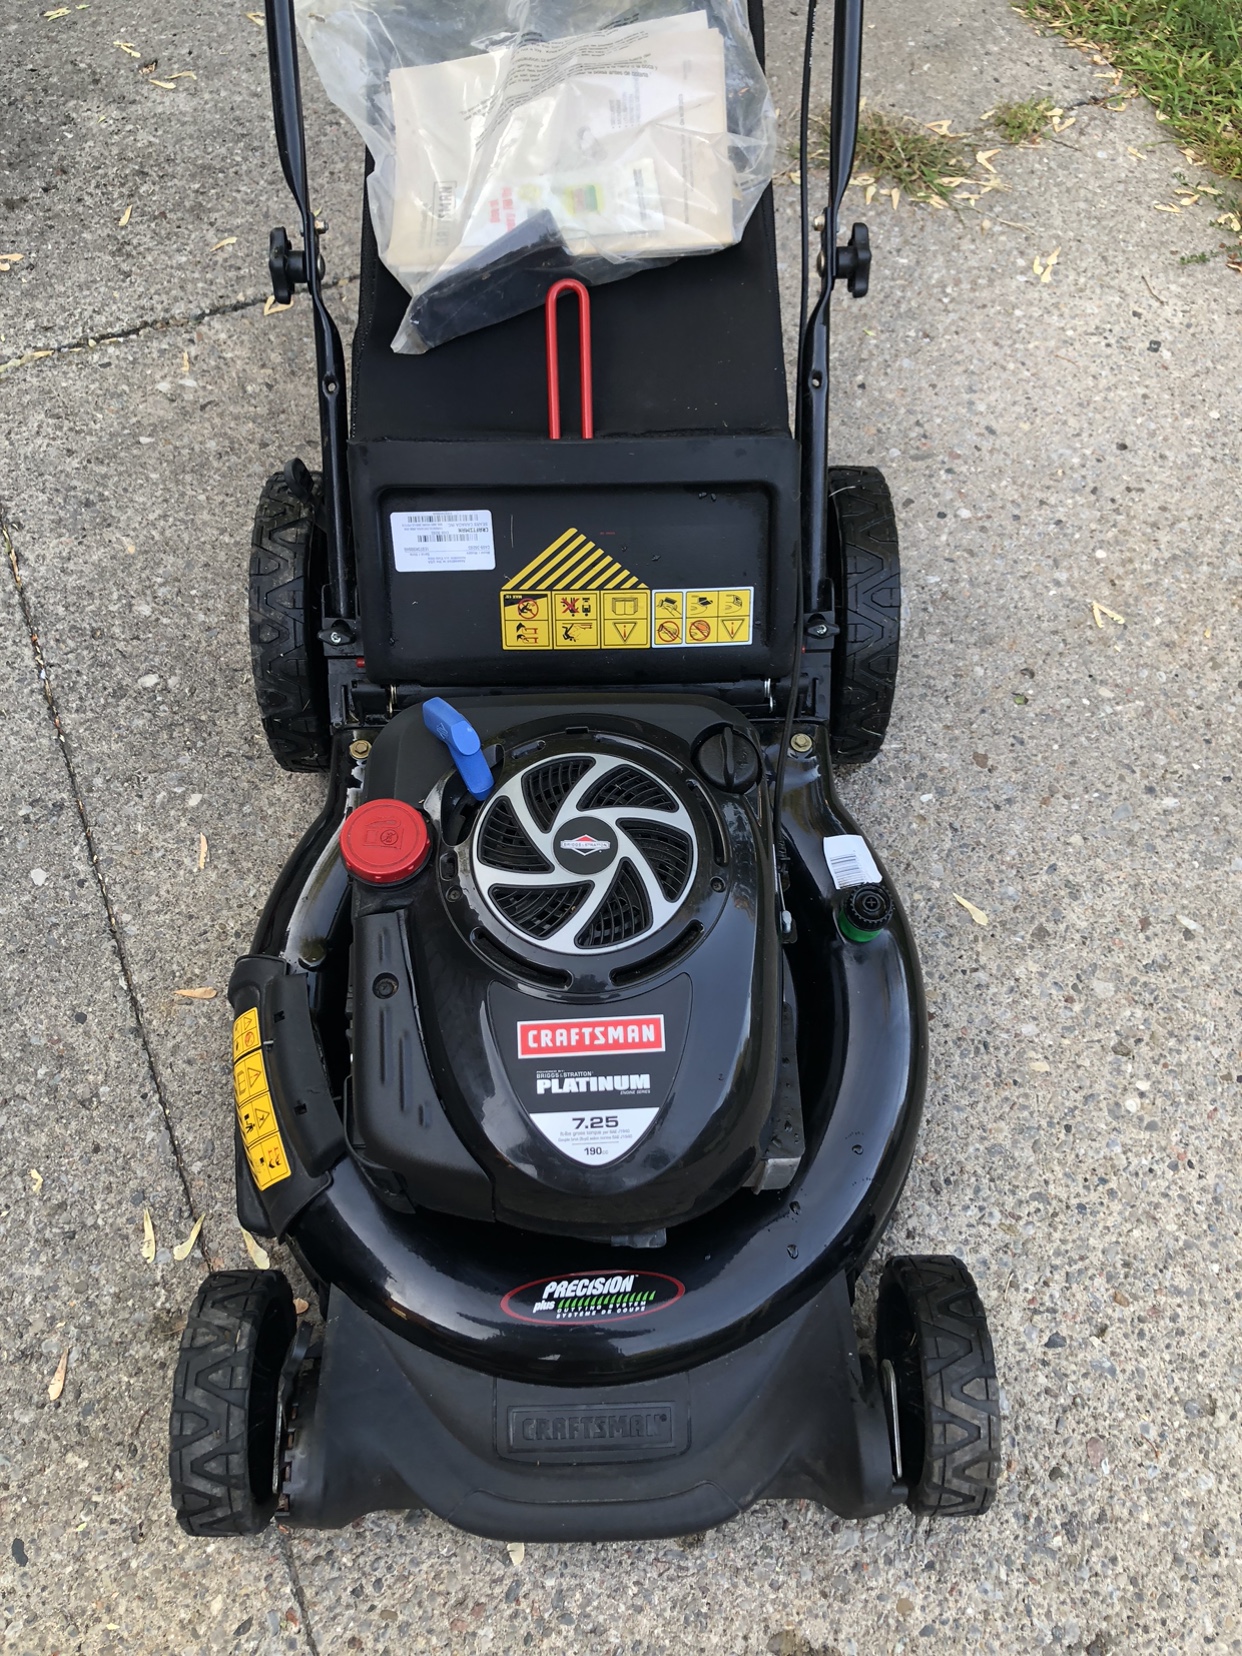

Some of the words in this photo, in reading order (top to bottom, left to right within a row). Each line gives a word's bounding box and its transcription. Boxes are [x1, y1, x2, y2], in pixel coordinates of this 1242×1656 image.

[528, 1024, 655, 1048] CRAFTSMAN
[536, 1074, 650, 1094] PLATINUM
[572, 1116, 618, 1129] 7.25
[542, 1275, 635, 1299] PRECISION
[533, 1300, 555, 1313] plus
[556, 1311, 596, 1319] SYSTÈME
[522, 1415, 662, 1440] CRAFTSMAN
